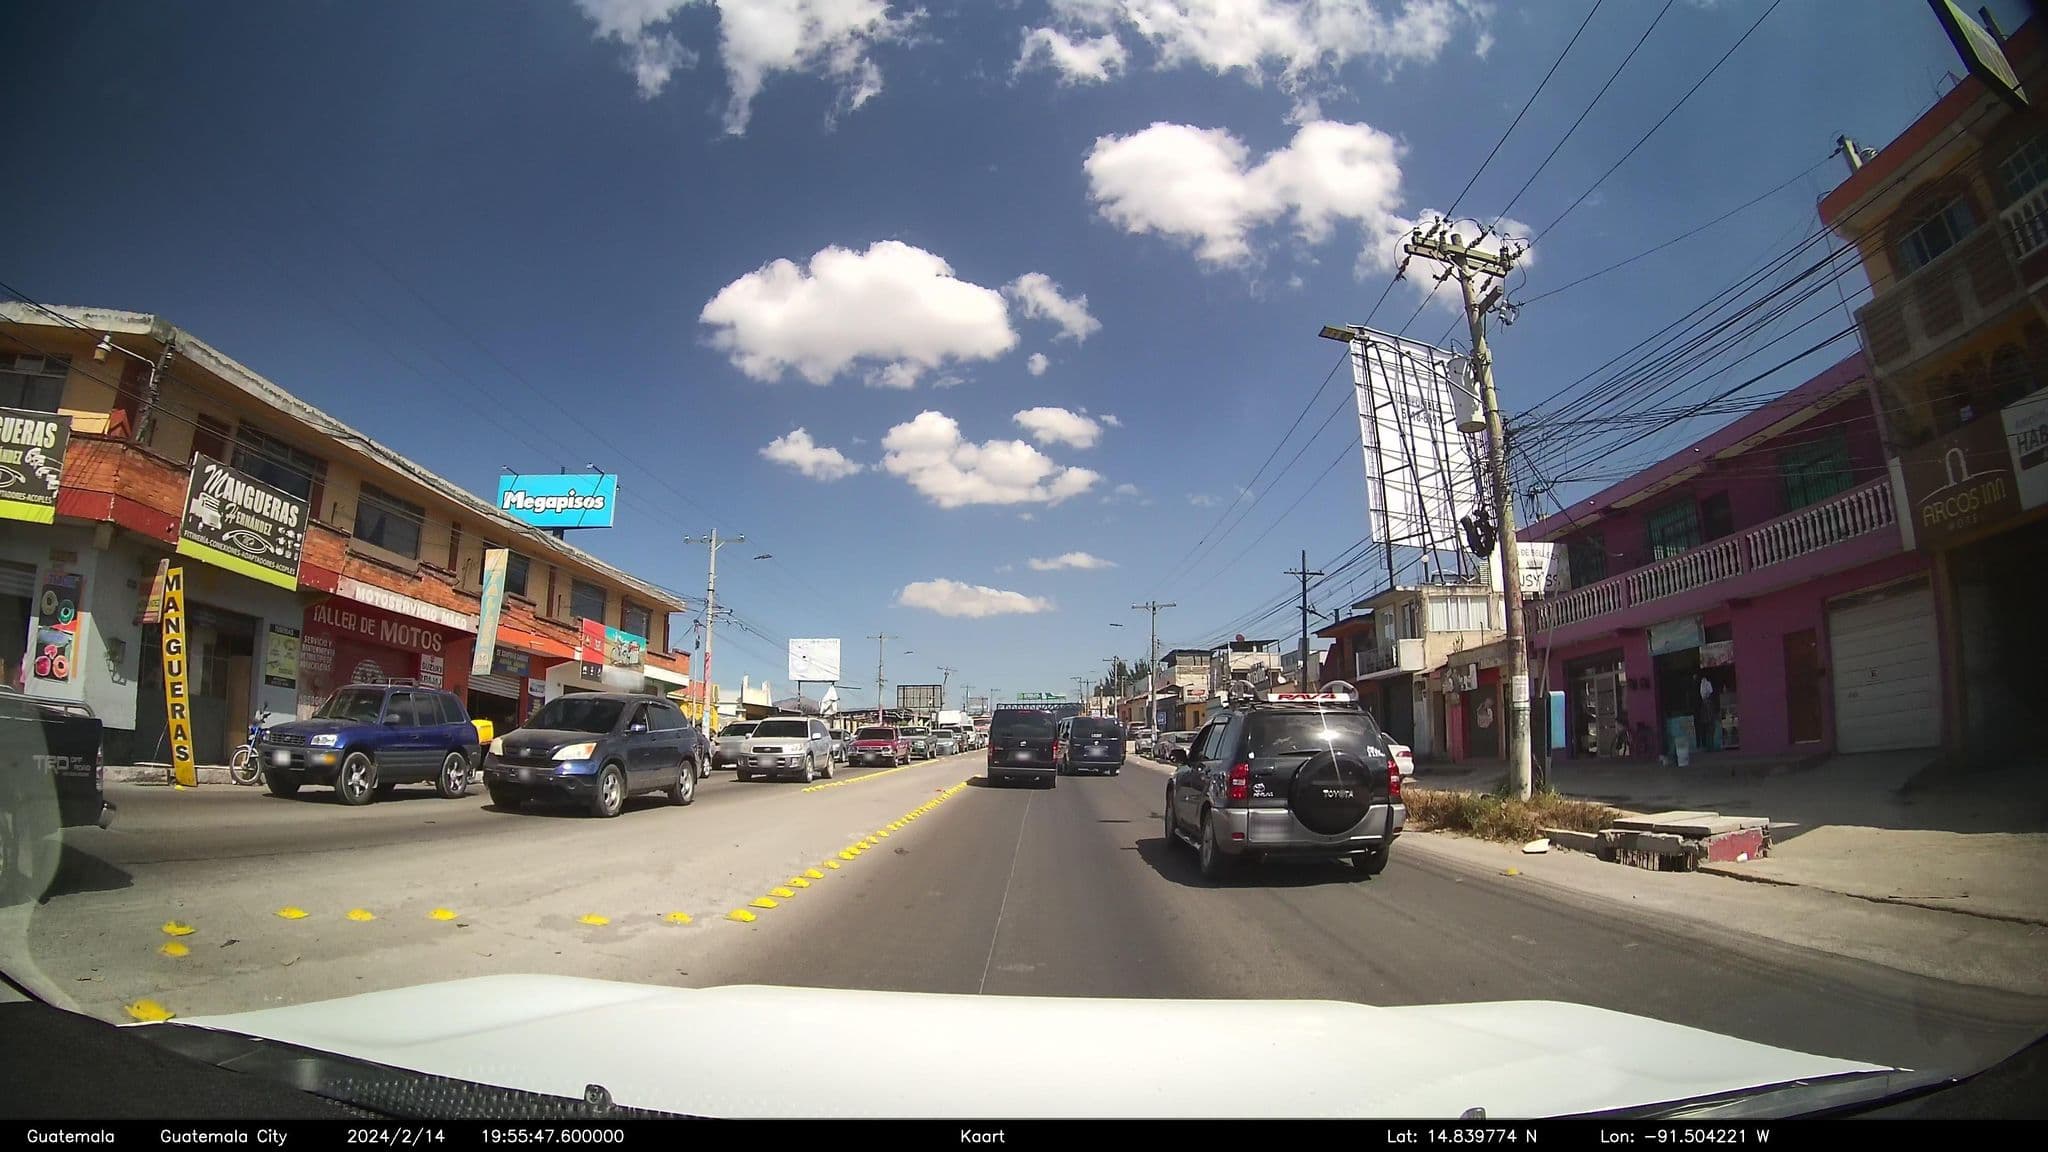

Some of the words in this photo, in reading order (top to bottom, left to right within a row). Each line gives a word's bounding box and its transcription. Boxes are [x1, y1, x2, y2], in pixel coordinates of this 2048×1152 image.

[204, 464, 300, 528] MANGUERAS
[502, 489, 605, 513] Megapisos
[1922, 487, 1980, 528] ARCOS
[224, 502, 273, 537] HERNÁNDEZ
[355, 586, 438, 621] MOTOSERVICIO
[313, 604, 357, 632] TALLER
[360, 616, 376, 636] DE
[380, 619, 443, 653] MOTOS
[163, 573, 192, 763] MANGUERAS
[32, 754, 70, 775] TRD
[1323, 788, 1354, 798] TOYOTA
